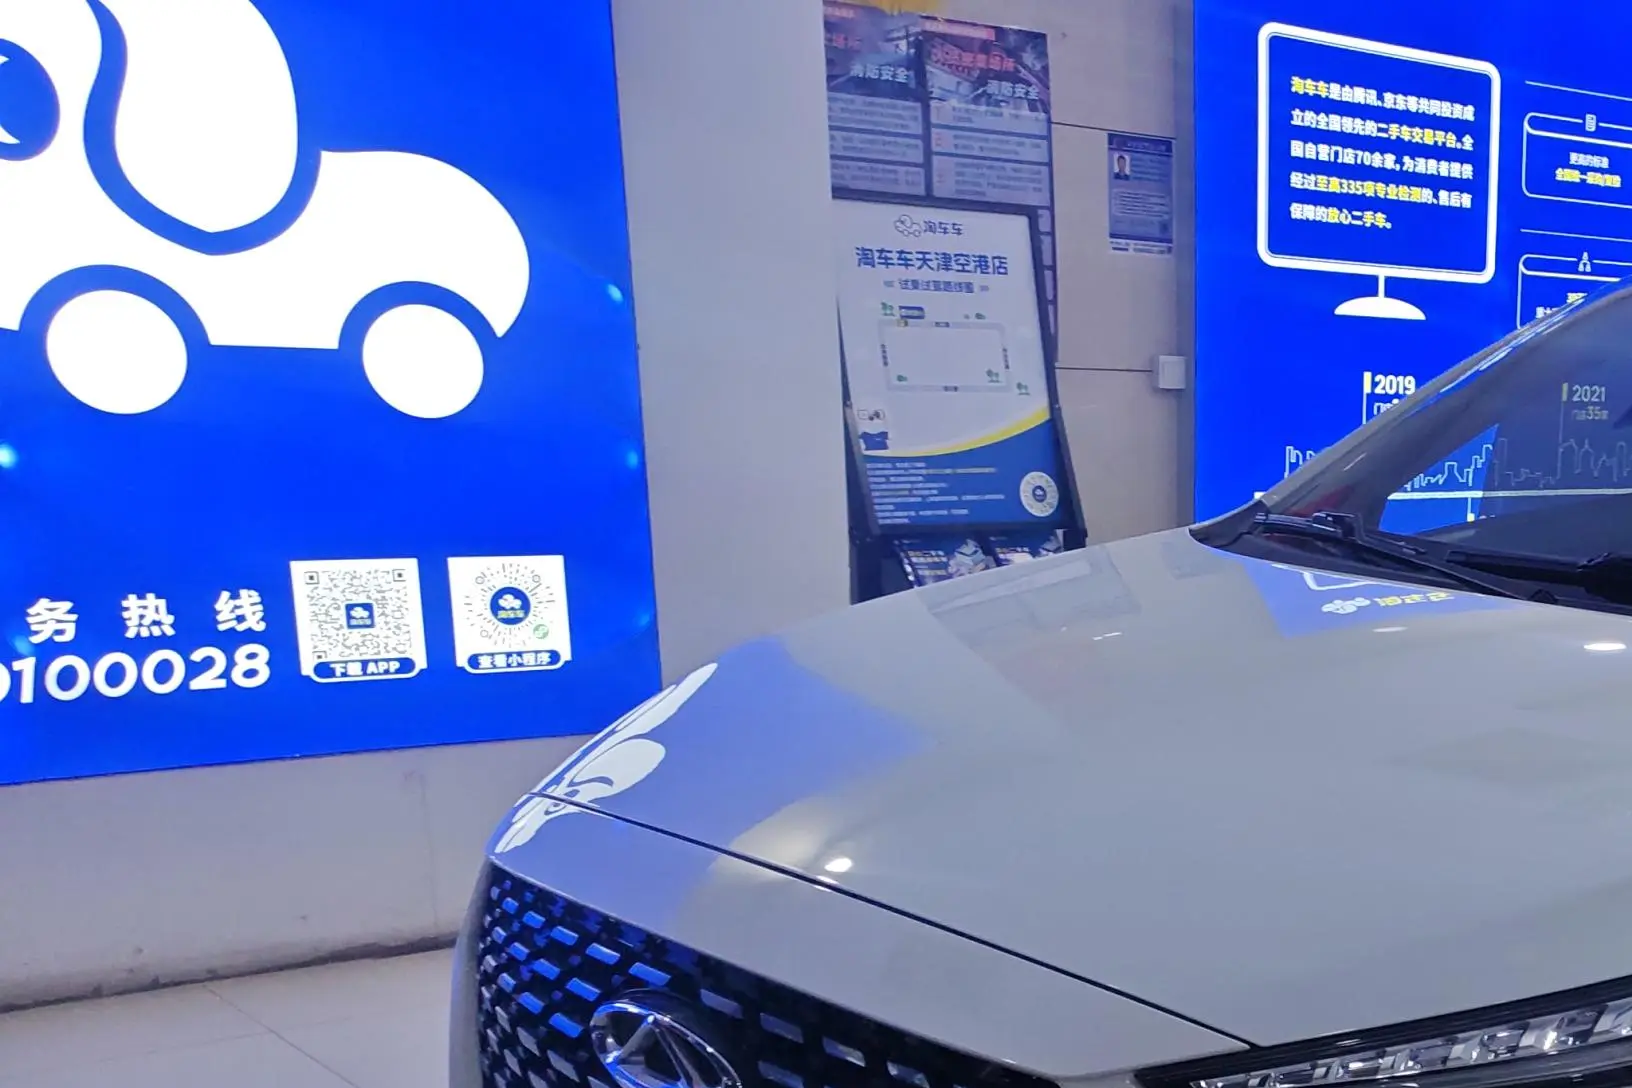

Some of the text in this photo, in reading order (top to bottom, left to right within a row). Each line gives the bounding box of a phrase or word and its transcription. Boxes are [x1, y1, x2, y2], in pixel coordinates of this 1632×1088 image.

[924, 220, 963, 236] 淘车车
[856, 246, 1009, 276] 淘车车天津空港店
[1374, 374, 1416, 395] 2019
[1572, 385, 1606, 402] 2021
[366, 661, 401, 676] APP
